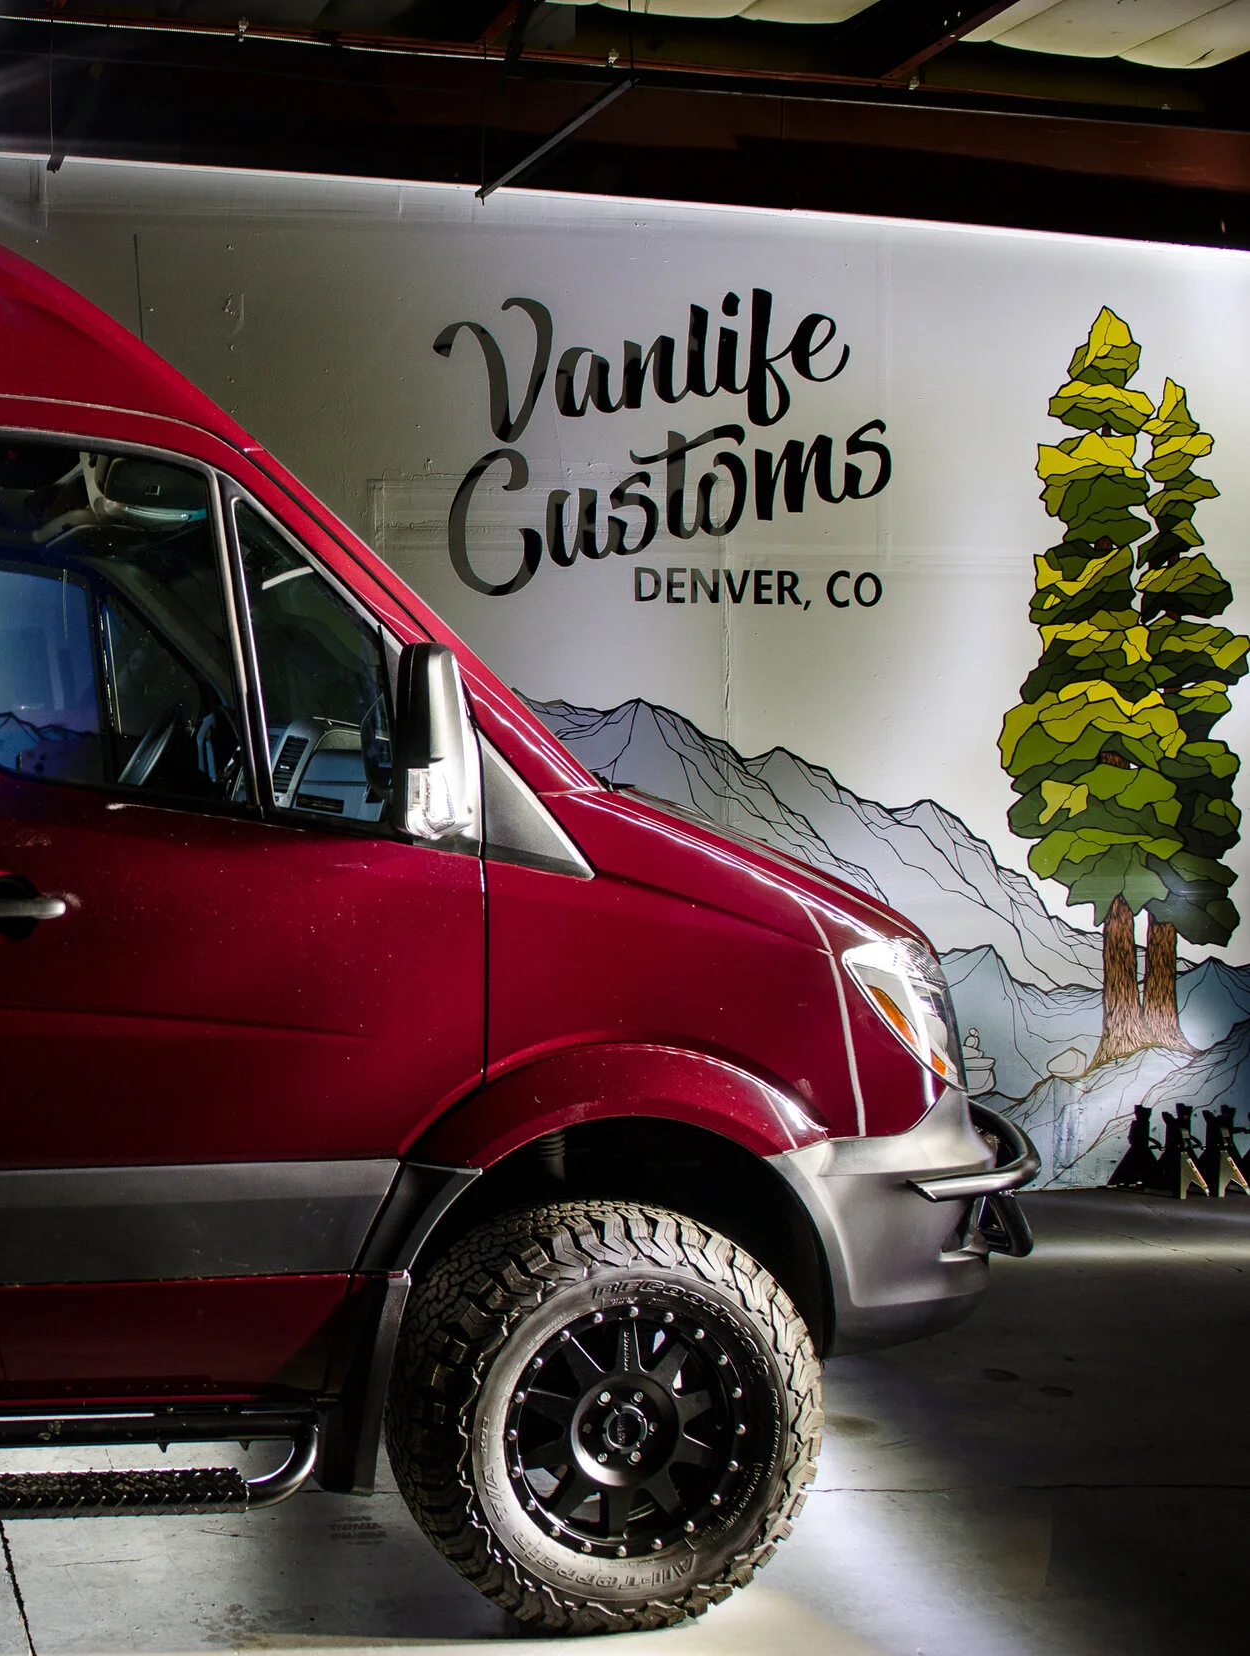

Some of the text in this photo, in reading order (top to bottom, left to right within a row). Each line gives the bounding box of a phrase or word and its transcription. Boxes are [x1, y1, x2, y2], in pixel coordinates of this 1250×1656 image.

[433, 288, 850, 443] Vanlife
[448, 418, 892, 597] Customs
[634, 566, 883, 611] DENVER, CO
